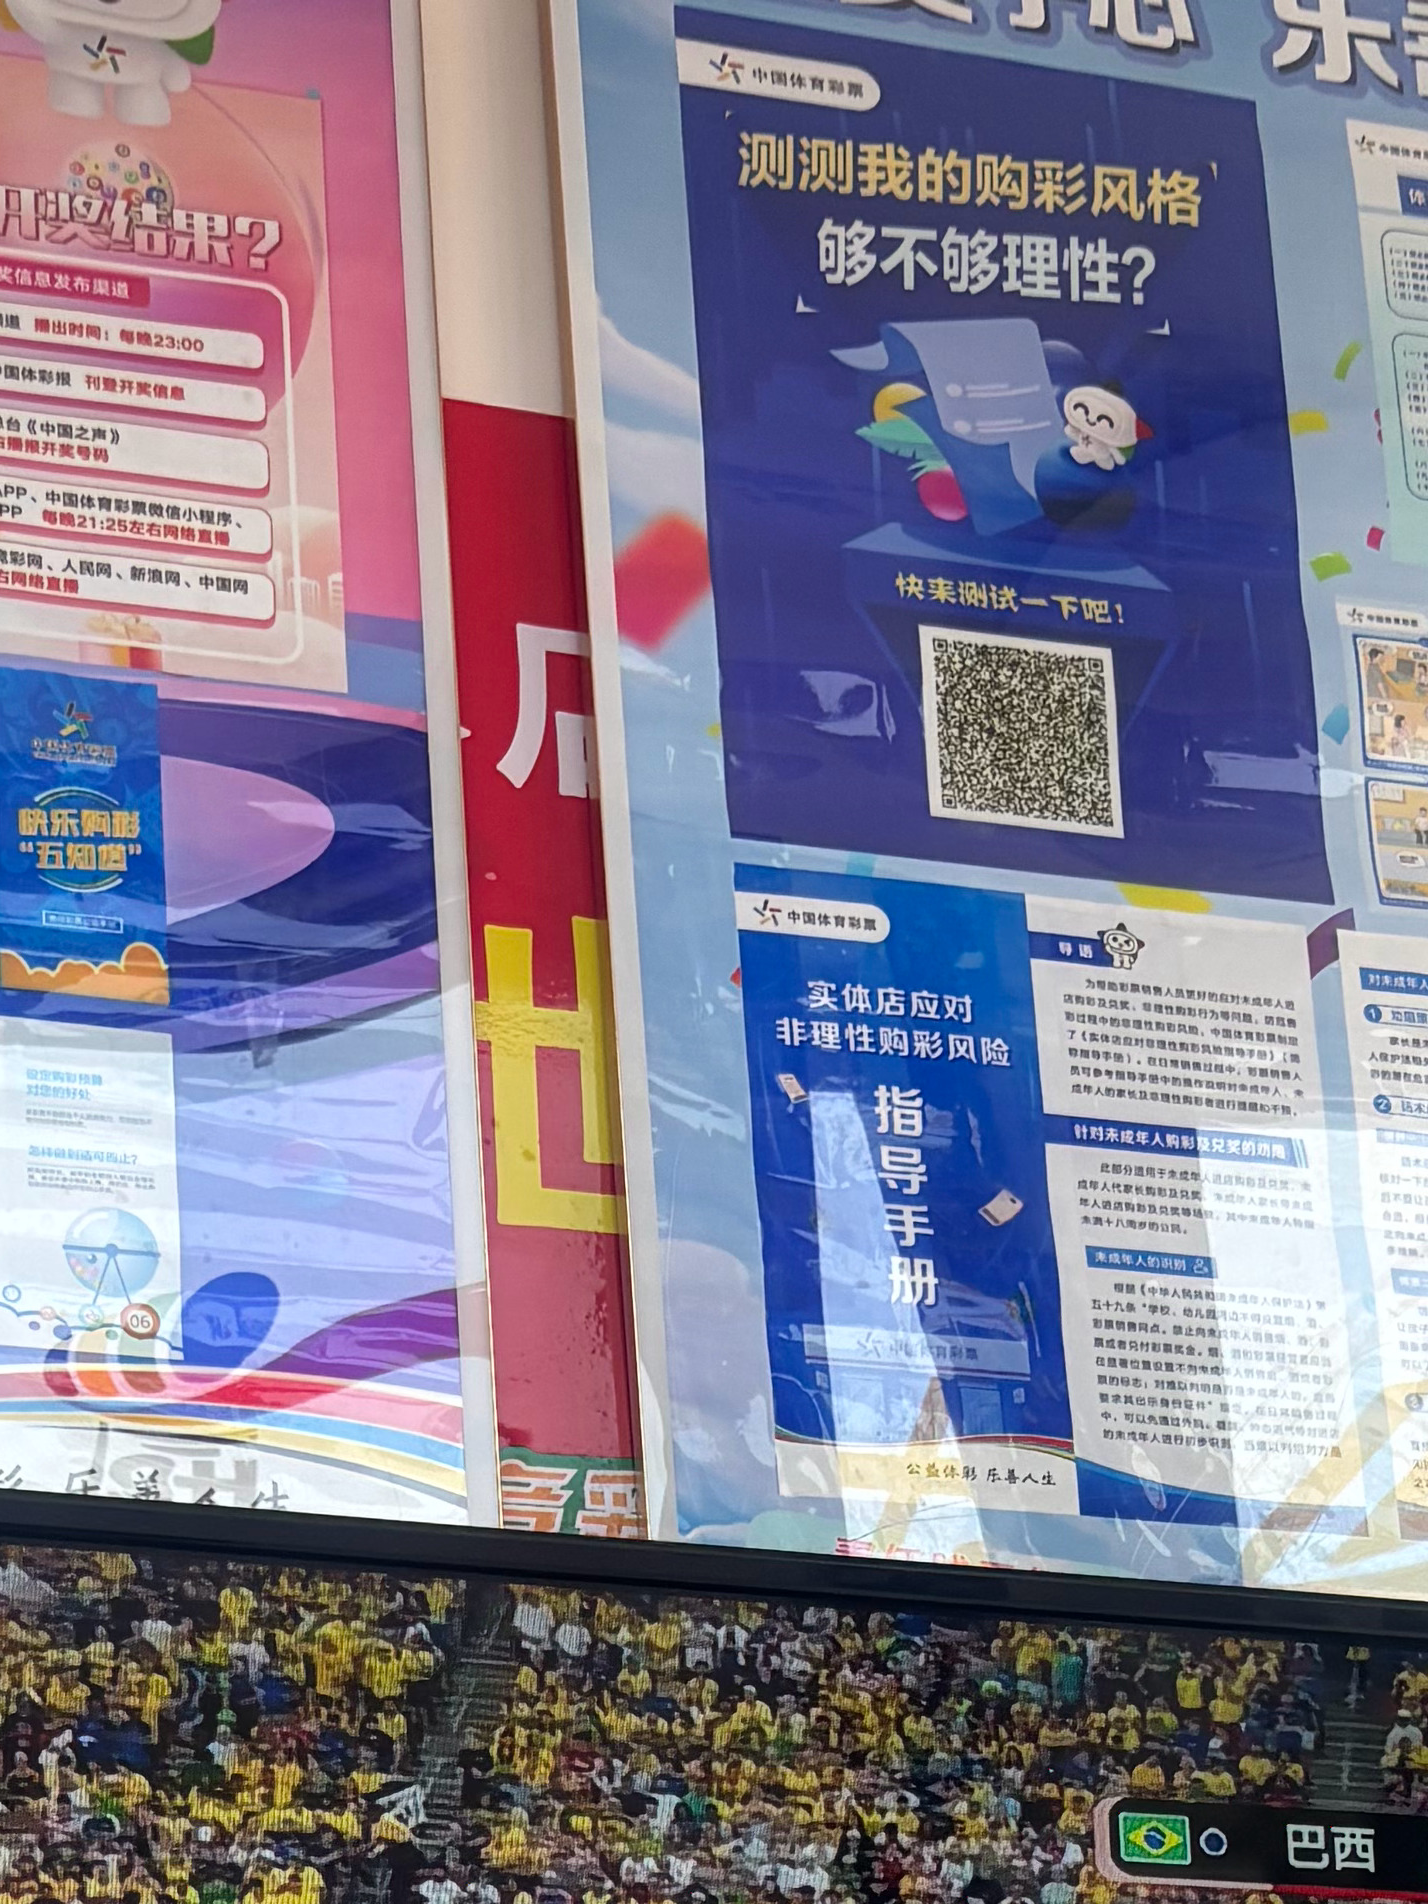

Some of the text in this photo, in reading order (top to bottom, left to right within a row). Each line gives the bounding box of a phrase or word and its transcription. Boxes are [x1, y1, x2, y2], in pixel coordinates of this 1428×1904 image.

[753, 68, 864, 99] 中国体育彩票
[738, 132, 1203, 227] 测测我的购彩风格
[818, 219, 1156, 305] 够不够理性?
[84, 374, 186, 403] 刊登开奖信息
[19, 810, 139, 838] 快乐购彩
[787, 909, 877, 931] 中国体育彩票
[807, 980, 972, 1023] 实体店应对
[776, 1019, 1011, 1066] 非理性购彩风险
[874, 1085, 939, 1306] 指导手册
[1095, 1251, 1186, 1271] 未成年人的识别
[129, 1313, 151, 1329] 06
[1286, 1825, 1376, 1874] 巴西
